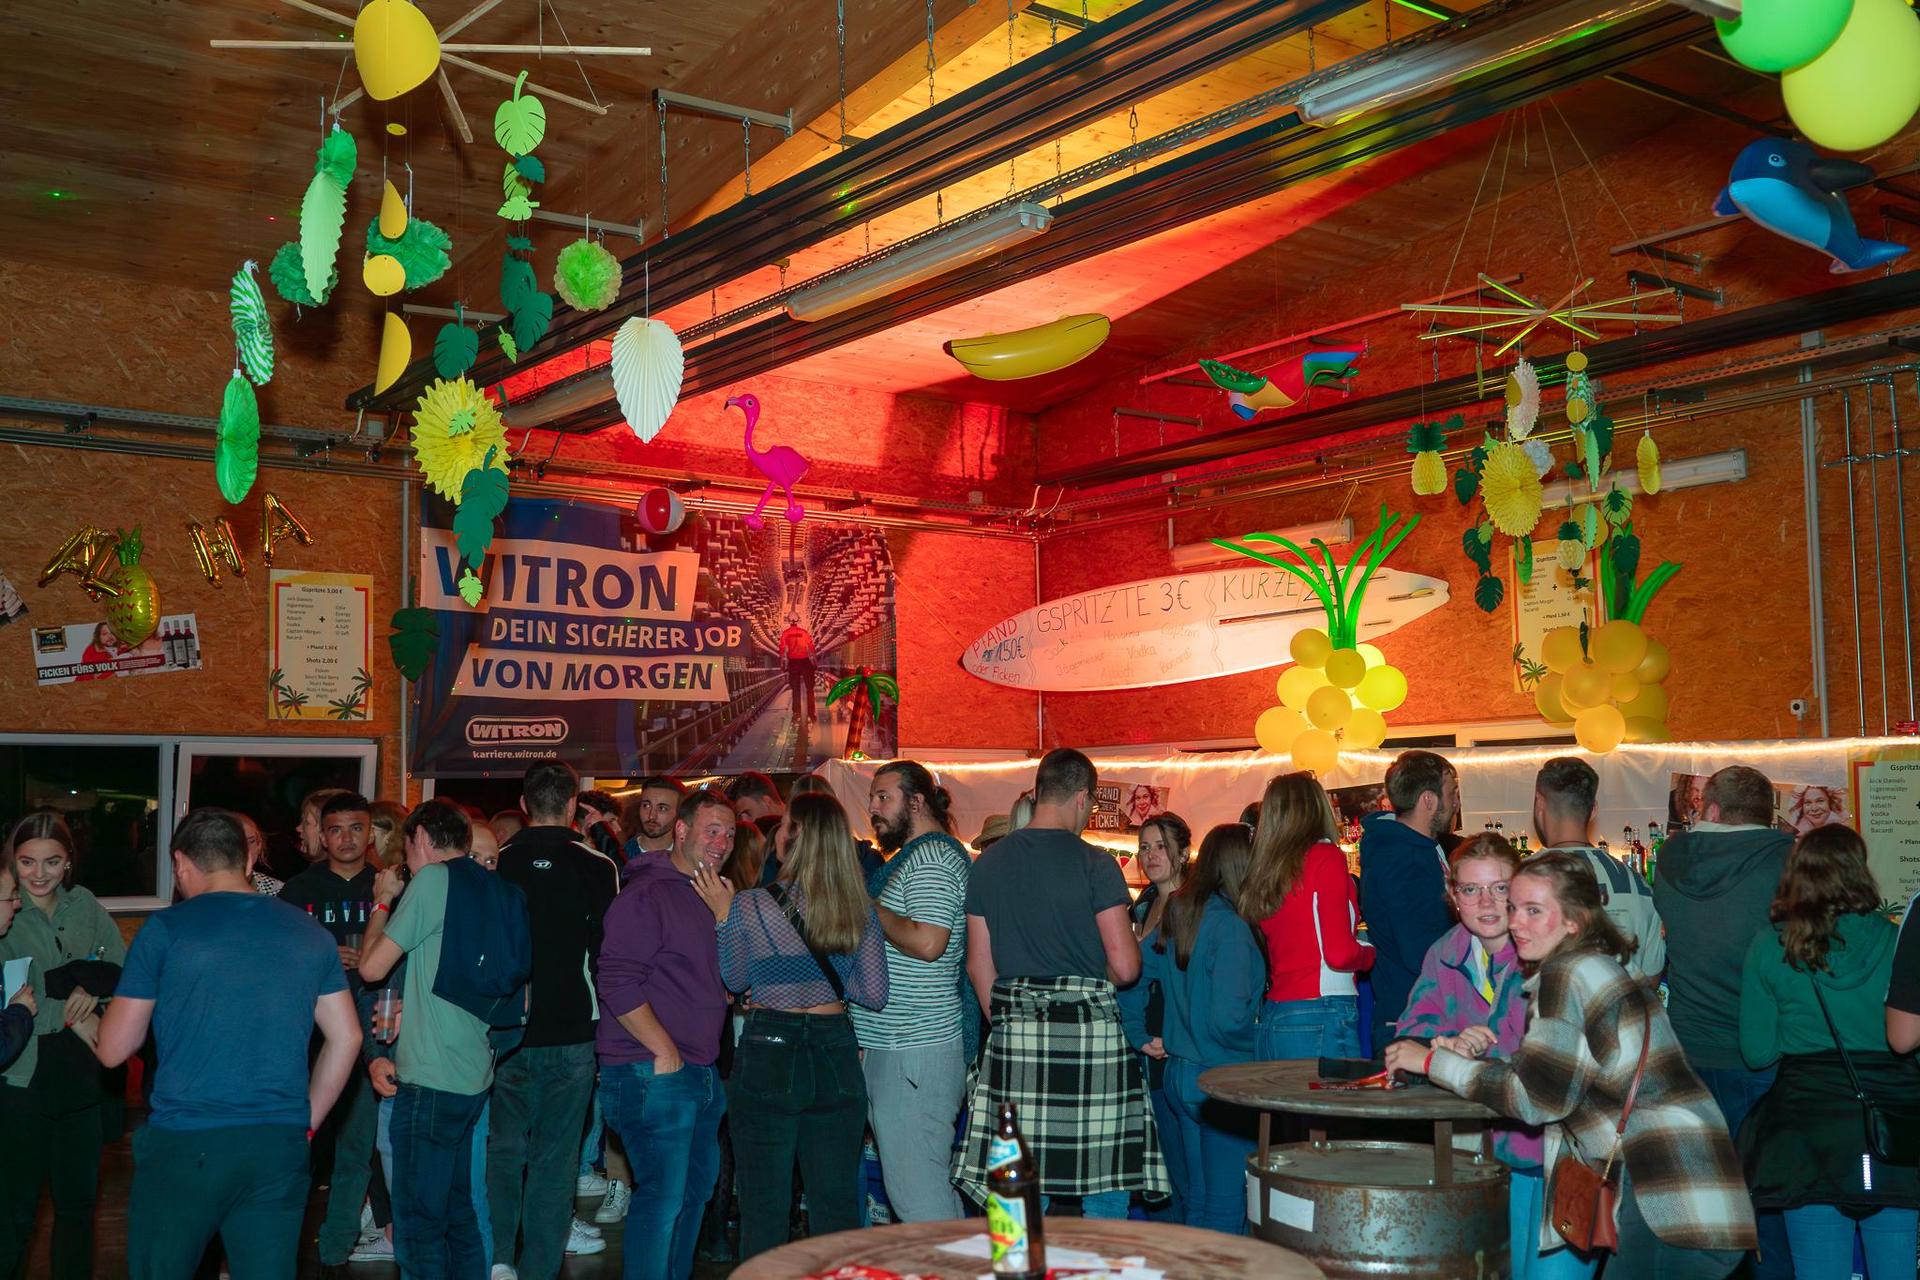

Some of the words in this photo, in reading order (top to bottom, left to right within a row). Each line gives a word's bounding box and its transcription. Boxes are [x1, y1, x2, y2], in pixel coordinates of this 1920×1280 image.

[435, 546, 677, 611] WITRON
[1223, 571, 1299, 603] KURZE
[1037, 584, 1151, 632] GSPRITZTE
[1160, 580, 1192, 612] 3€
[490, 617, 556, 645] DEIN
[565, 622, 688, 650] SICHERER
[694, 626, 742, 652] JOB
[39, 667, 70, 679] FICKEN
[71, 663, 96, 675] FÜRS
[96, 661, 118, 672] VOLK
[472, 658, 553, 690] VON
[562, 662, 713, 691] MORGEN
[472, 723, 562, 739] WITRON
[472, 749, 557, 760] karriere.witron.de
[1089, 814, 1120, 828] FICKEN
